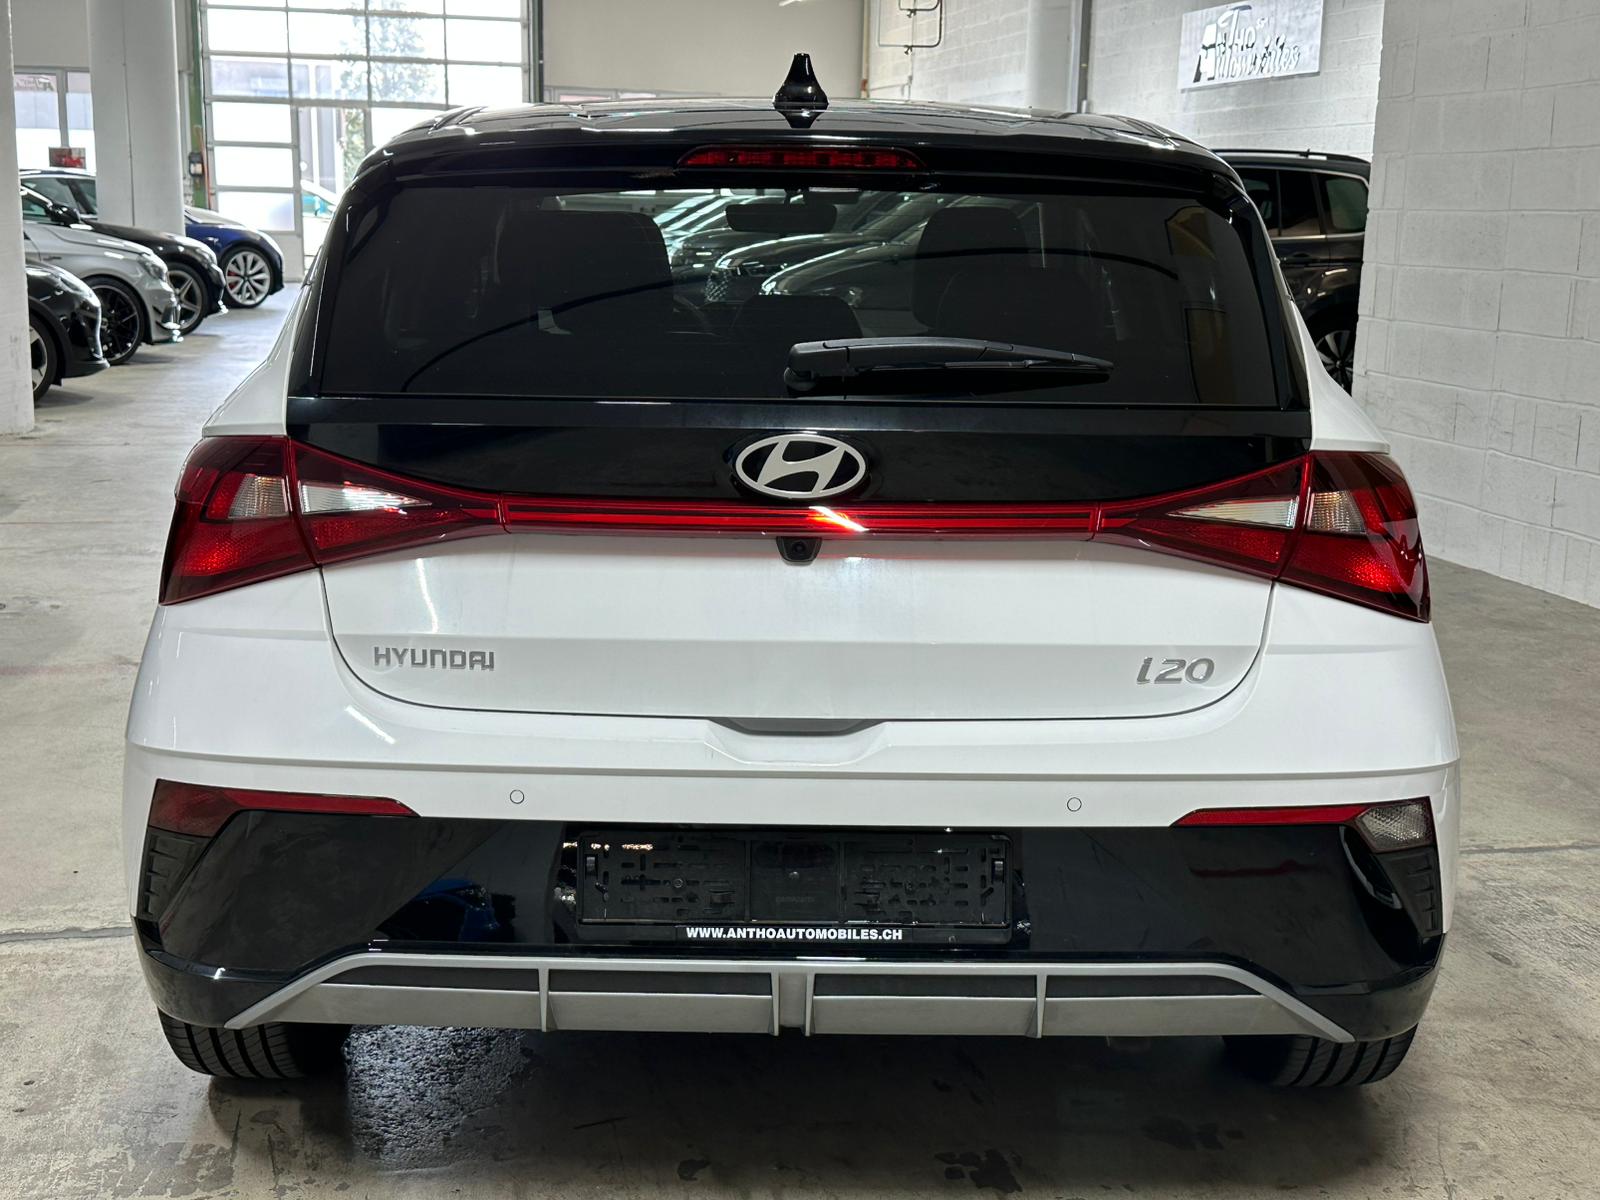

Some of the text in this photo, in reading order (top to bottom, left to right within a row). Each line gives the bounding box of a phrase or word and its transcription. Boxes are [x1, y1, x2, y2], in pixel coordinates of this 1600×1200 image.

[374, 646, 495, 671] HYUNDAI
[1136, 657, 1215, 684] i20
[686, 927, 903, 940] WWW.ANTHOAUTOMOBILES.CH
